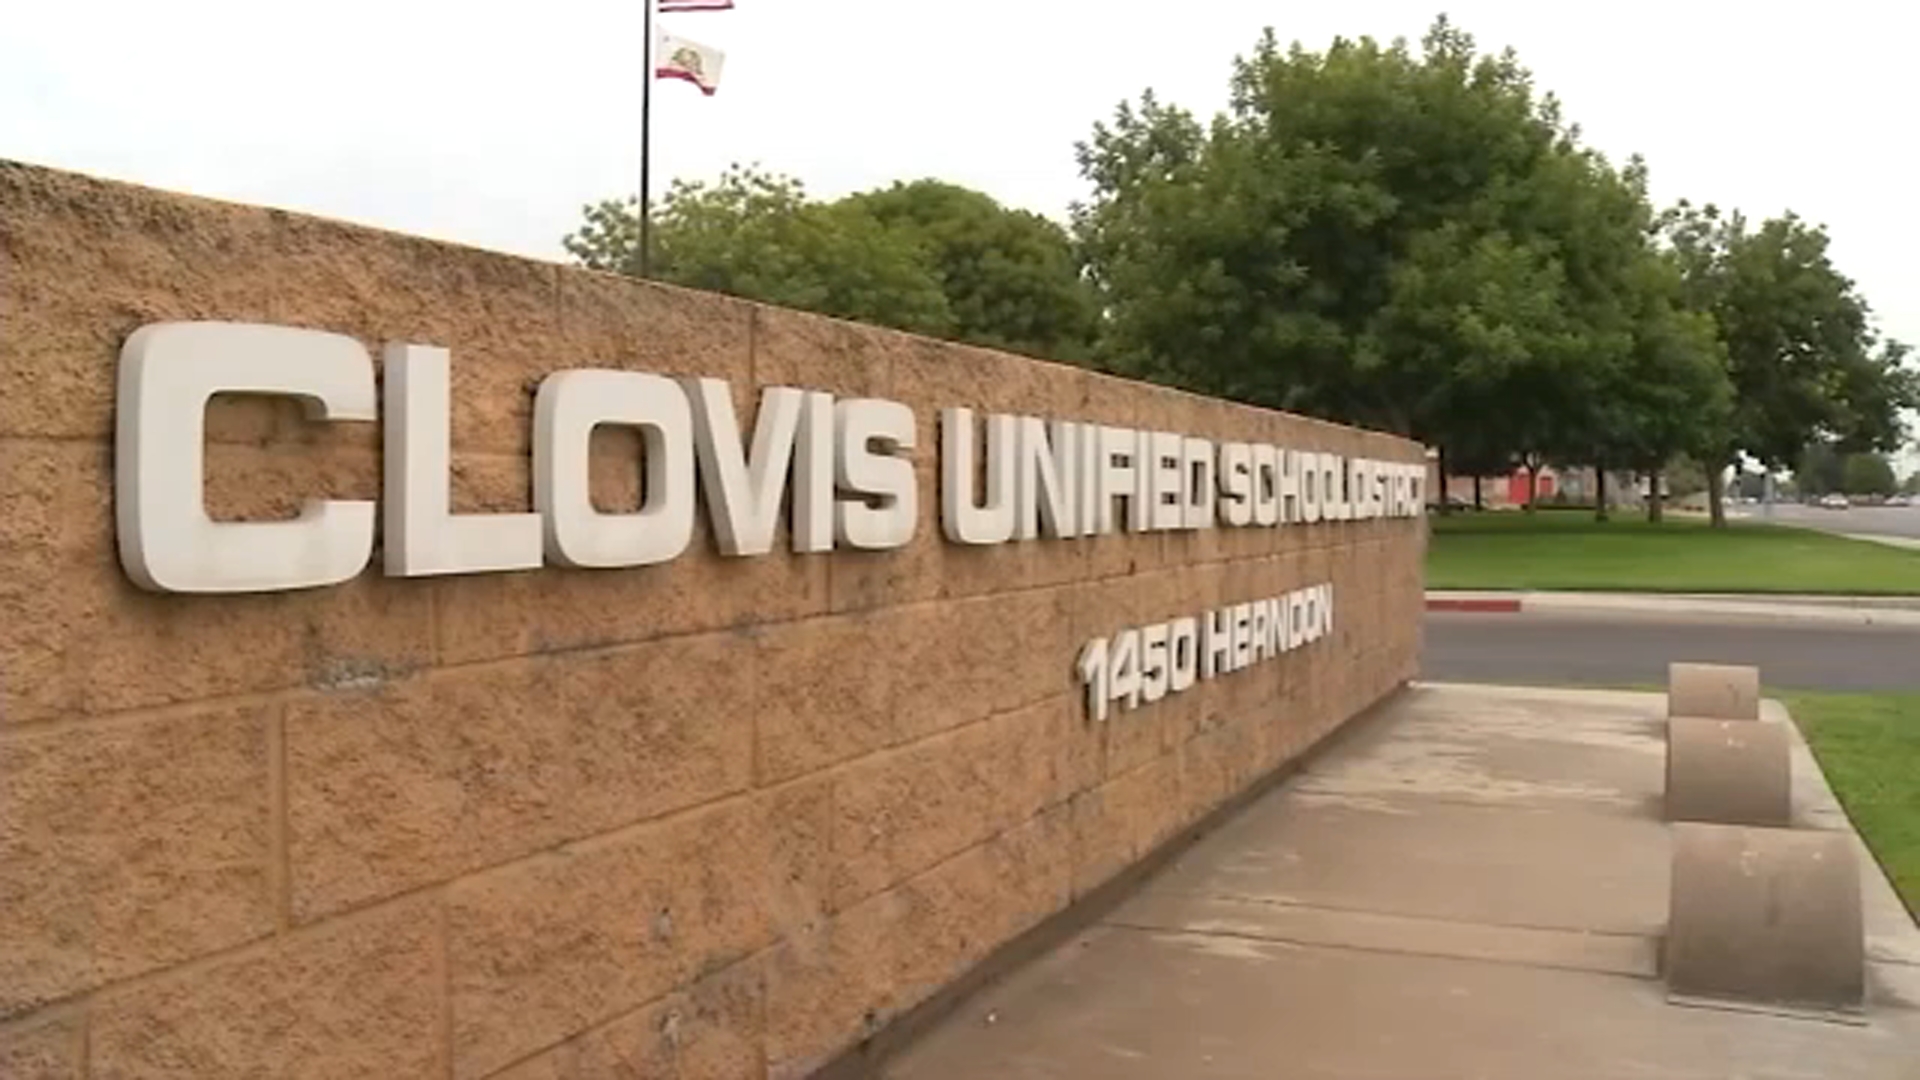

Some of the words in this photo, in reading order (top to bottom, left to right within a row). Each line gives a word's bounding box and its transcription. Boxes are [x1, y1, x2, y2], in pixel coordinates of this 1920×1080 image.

[116, 321, 917, 594] CLOVIS
[941, 406, 1213, 544] UNIFIED
[1219, 443, 1350, 526] SCHOOL
[1077, 616, 1197, 721] 1450
[1203, 582, 1333, 679] HERNDON
